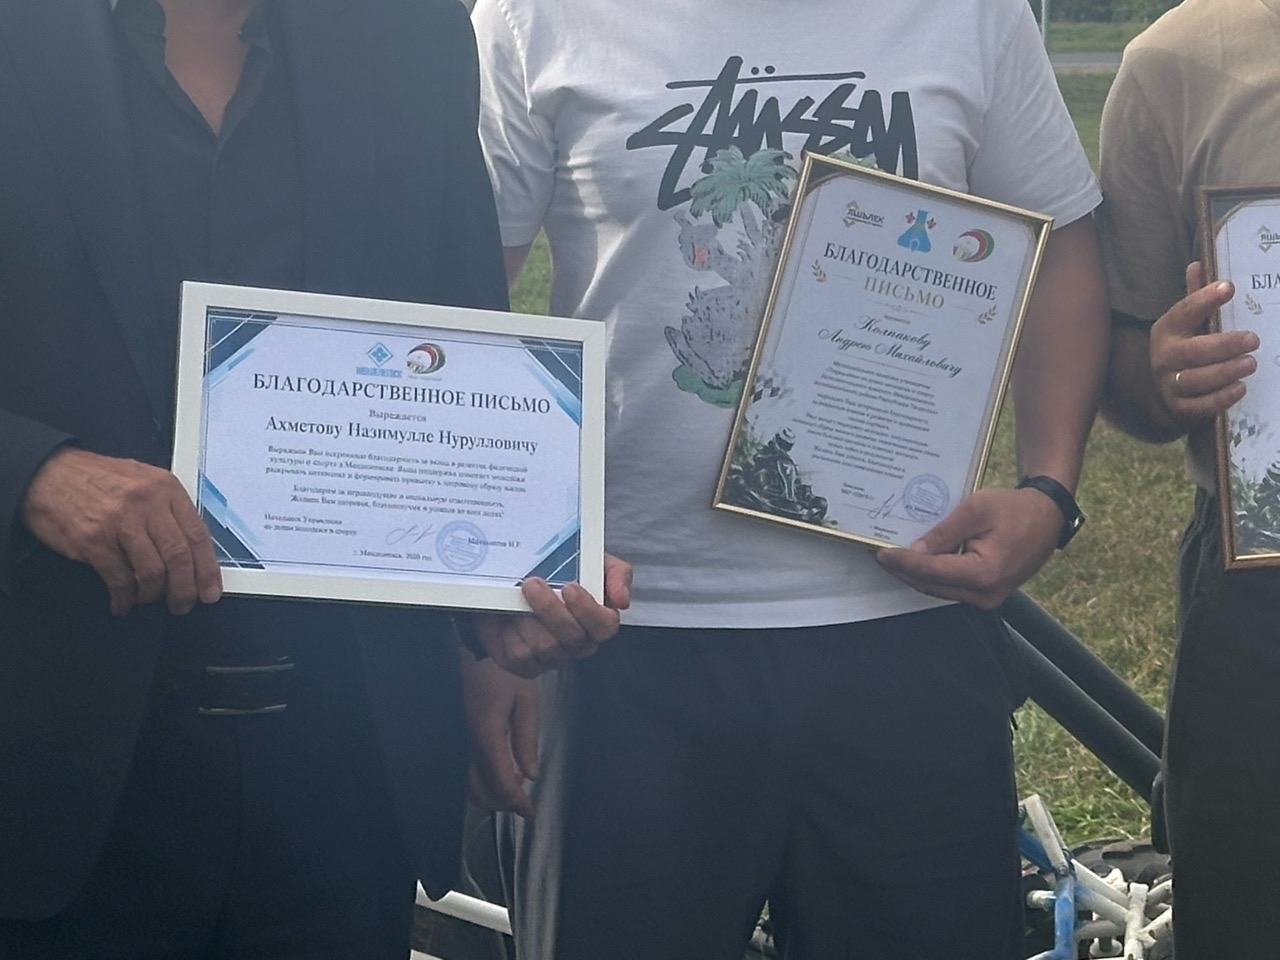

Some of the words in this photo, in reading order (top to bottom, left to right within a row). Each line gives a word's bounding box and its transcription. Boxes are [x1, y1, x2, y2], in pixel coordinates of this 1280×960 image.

[823, 242, 998, 301] БЛАГОДАРСТВЕННОЕ
[863, 276, 945, 310] ПИСЬМО
[817, 328, 872, 352] Андрею
[874, 343, 962, 378] Михайловичу
[253, 373, 466, 408] БЛАГОДАРСТВЕННОЕ
[470, 392, 551, 415] ПИСЬМО
[265, 416, 343, 438] Ахметову
[348, 422, 434, 445] Назимулле
[438, 432, 538, 456] Нурулловичу
